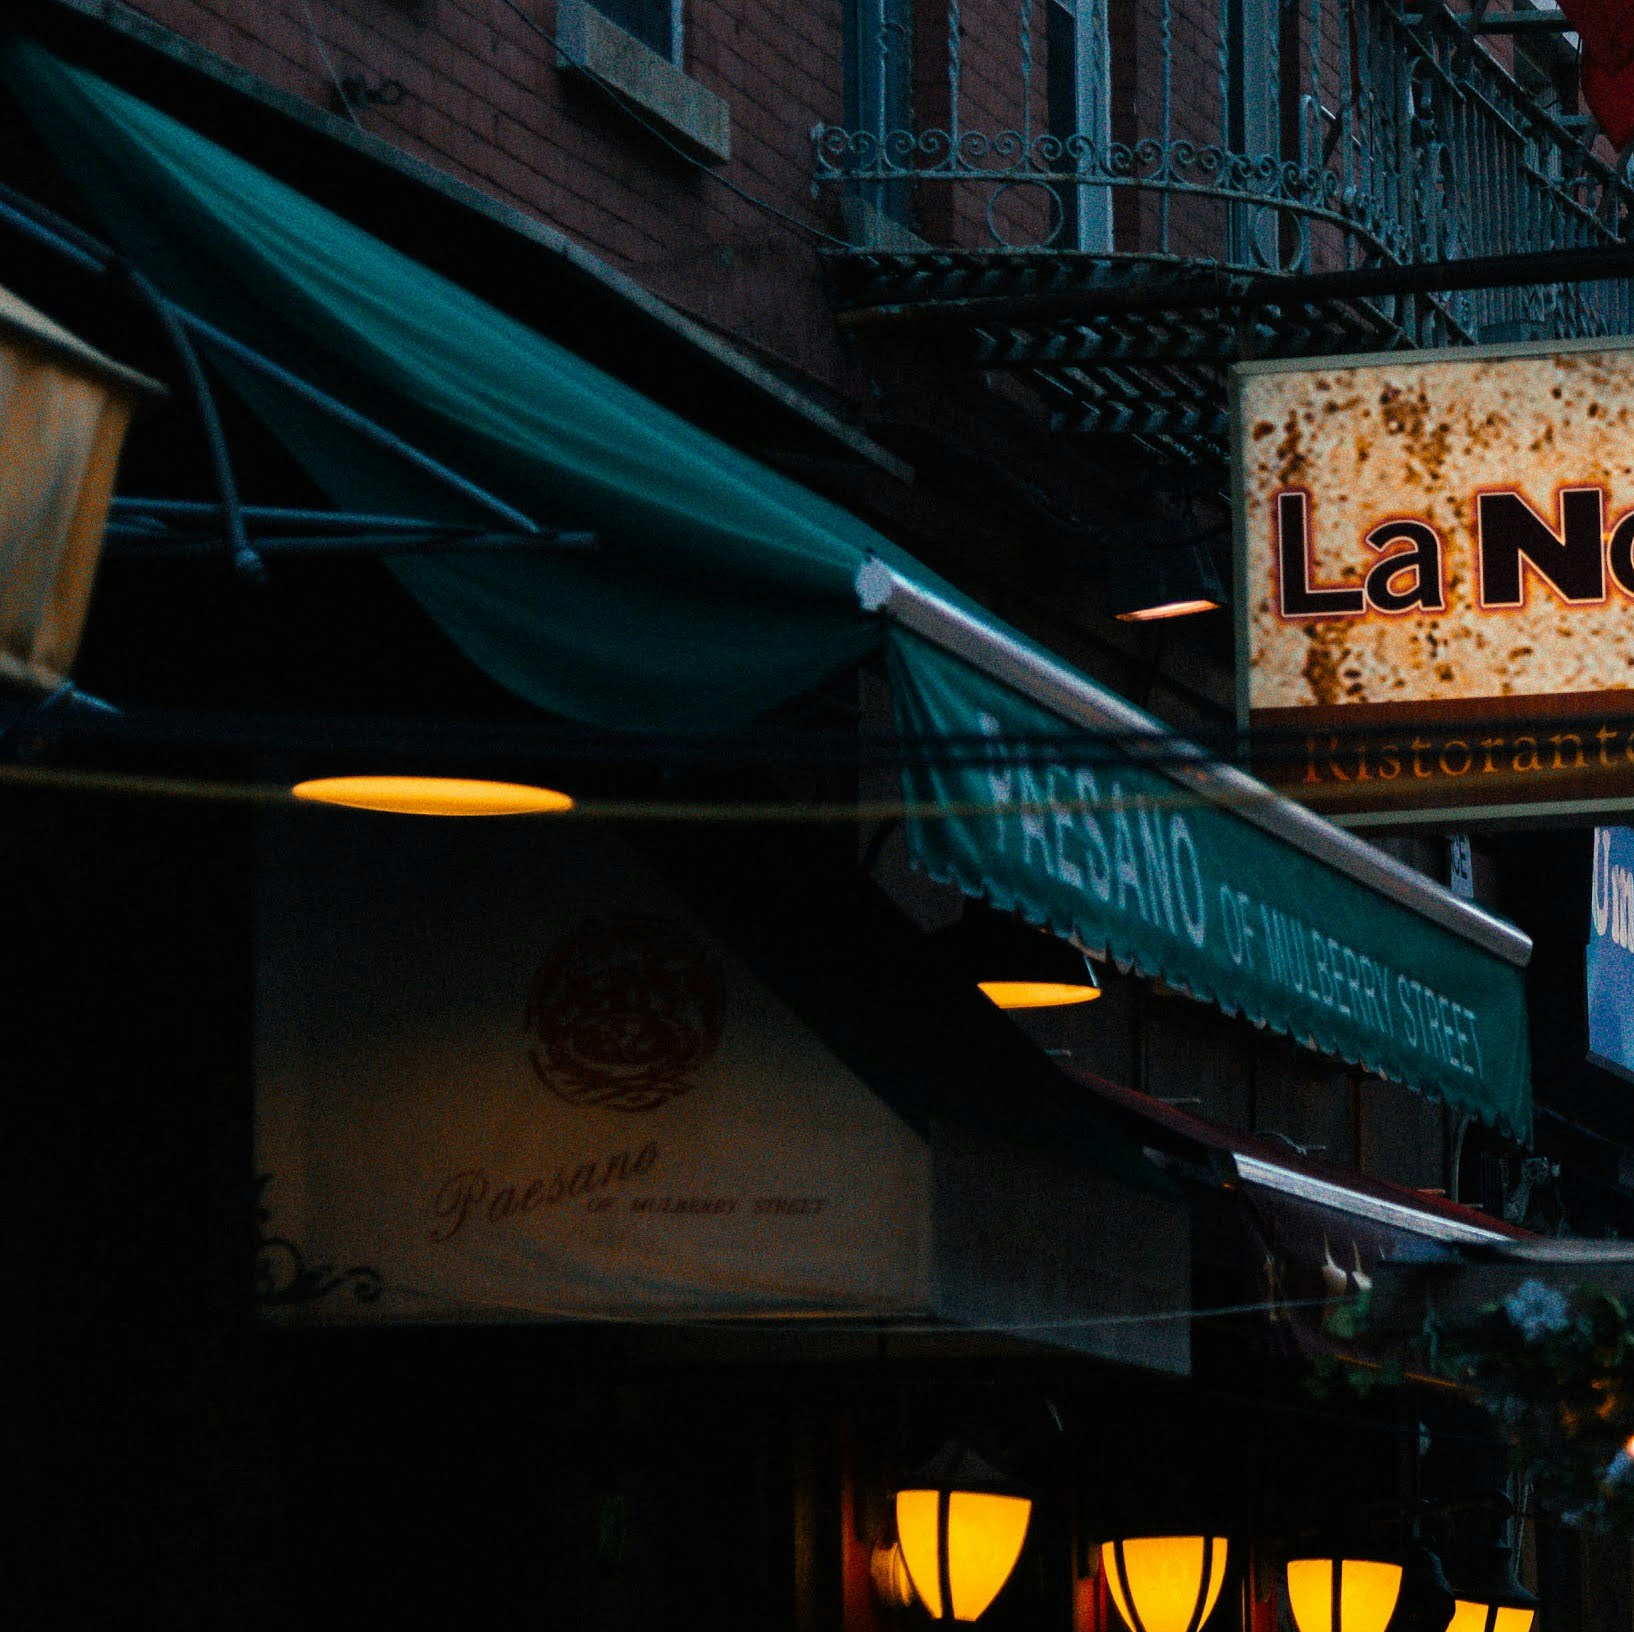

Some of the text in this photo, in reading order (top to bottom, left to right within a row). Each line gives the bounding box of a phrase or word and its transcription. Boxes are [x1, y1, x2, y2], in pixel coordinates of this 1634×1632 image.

[1275, 489, 1446, 619] La
[1219, 884, 1484, 1078] OF MULBERRY STREET
[429, 1141, 660, 1244] Paesano
